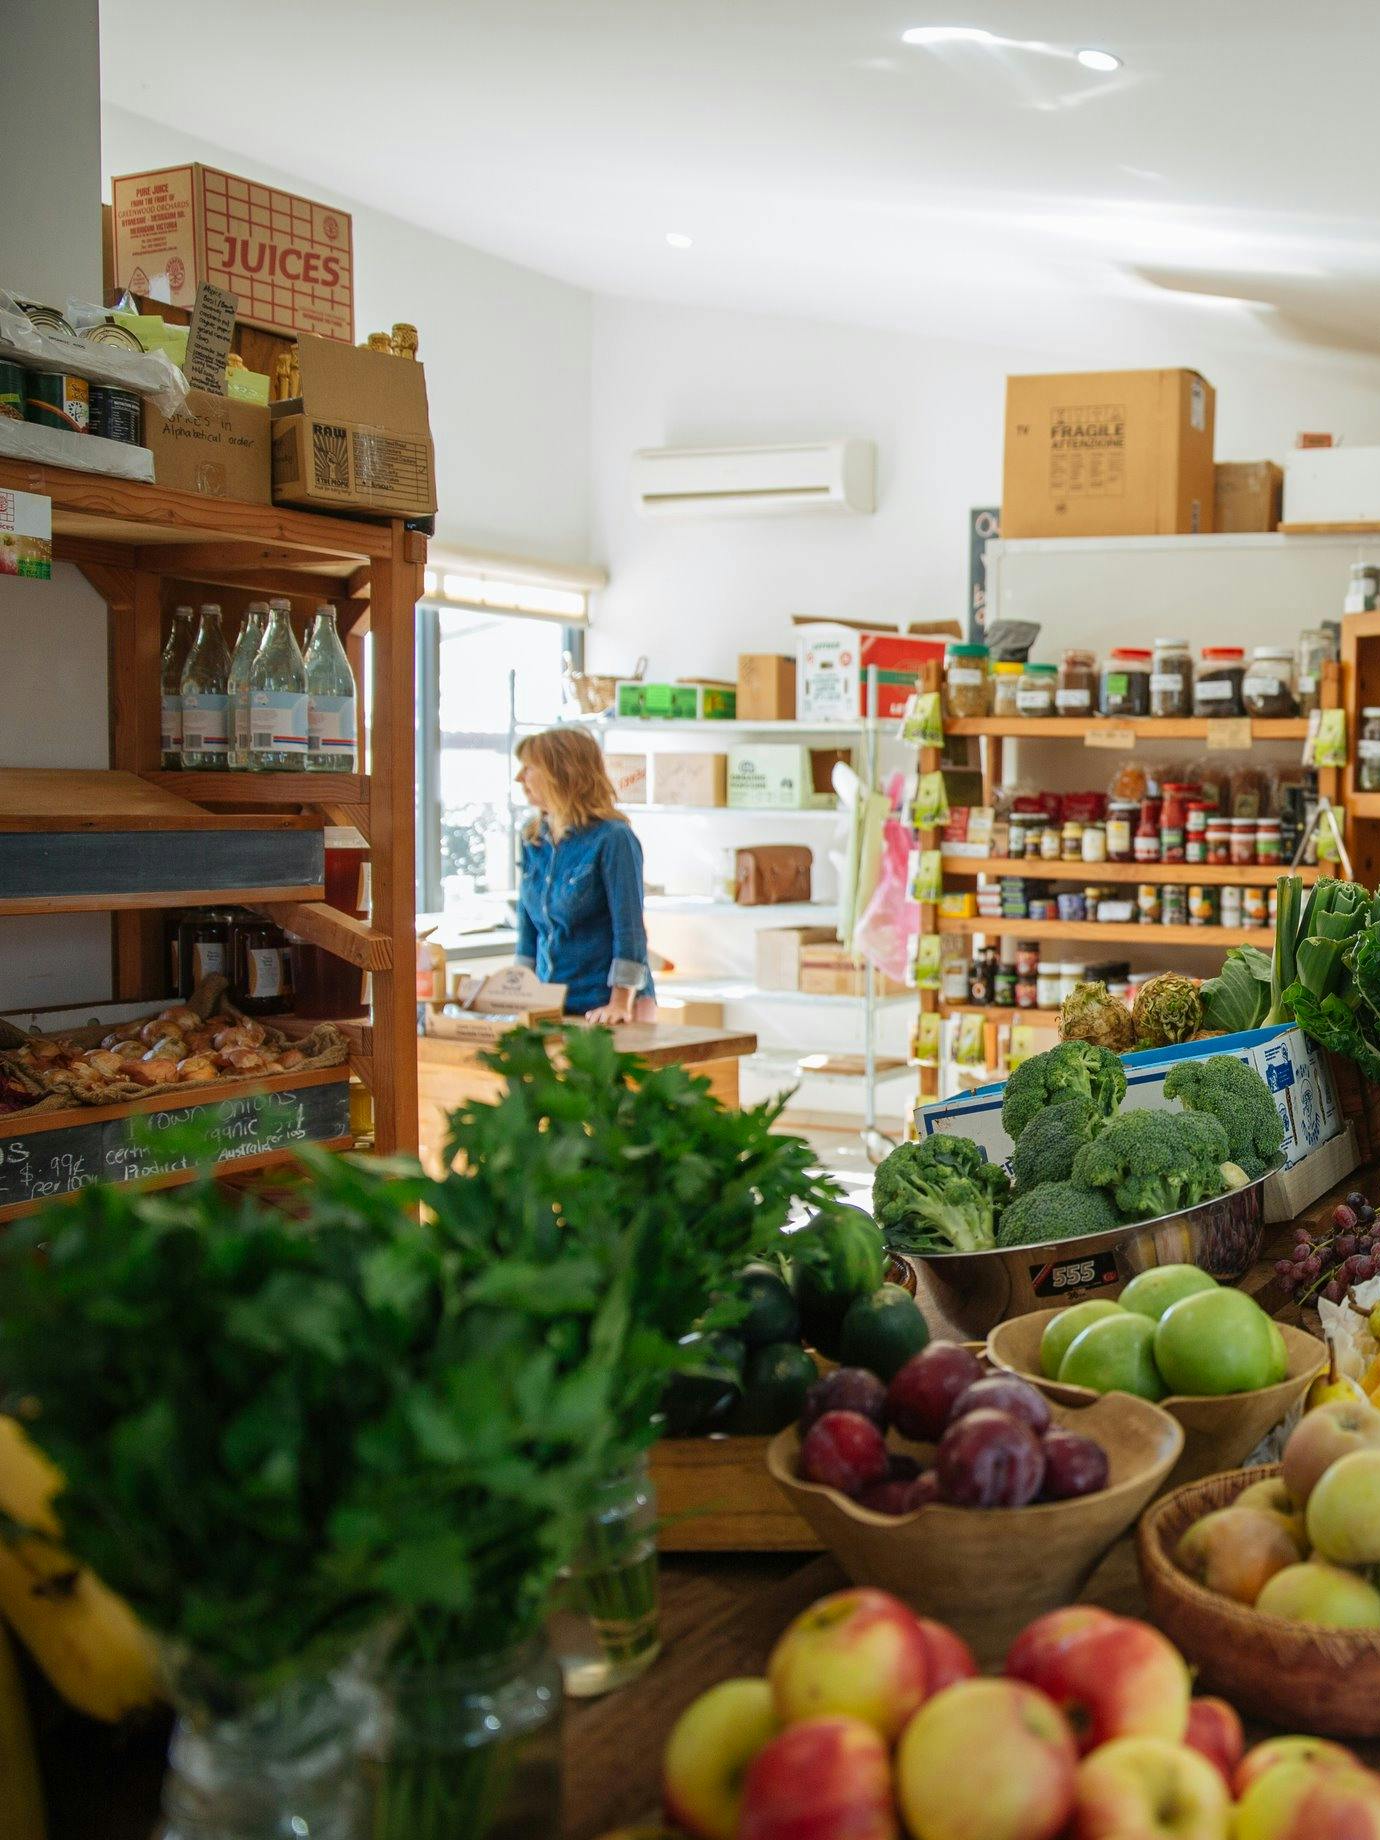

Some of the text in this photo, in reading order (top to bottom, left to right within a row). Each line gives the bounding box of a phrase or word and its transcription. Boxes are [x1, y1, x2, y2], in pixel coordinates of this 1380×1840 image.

[222, 236, 340, 287] JUICES
[313, 424, 347, 437] RAW
[1051, 423, 1124, 438] FRAGILE
[1053, 1260, 1095, 1288] 555
